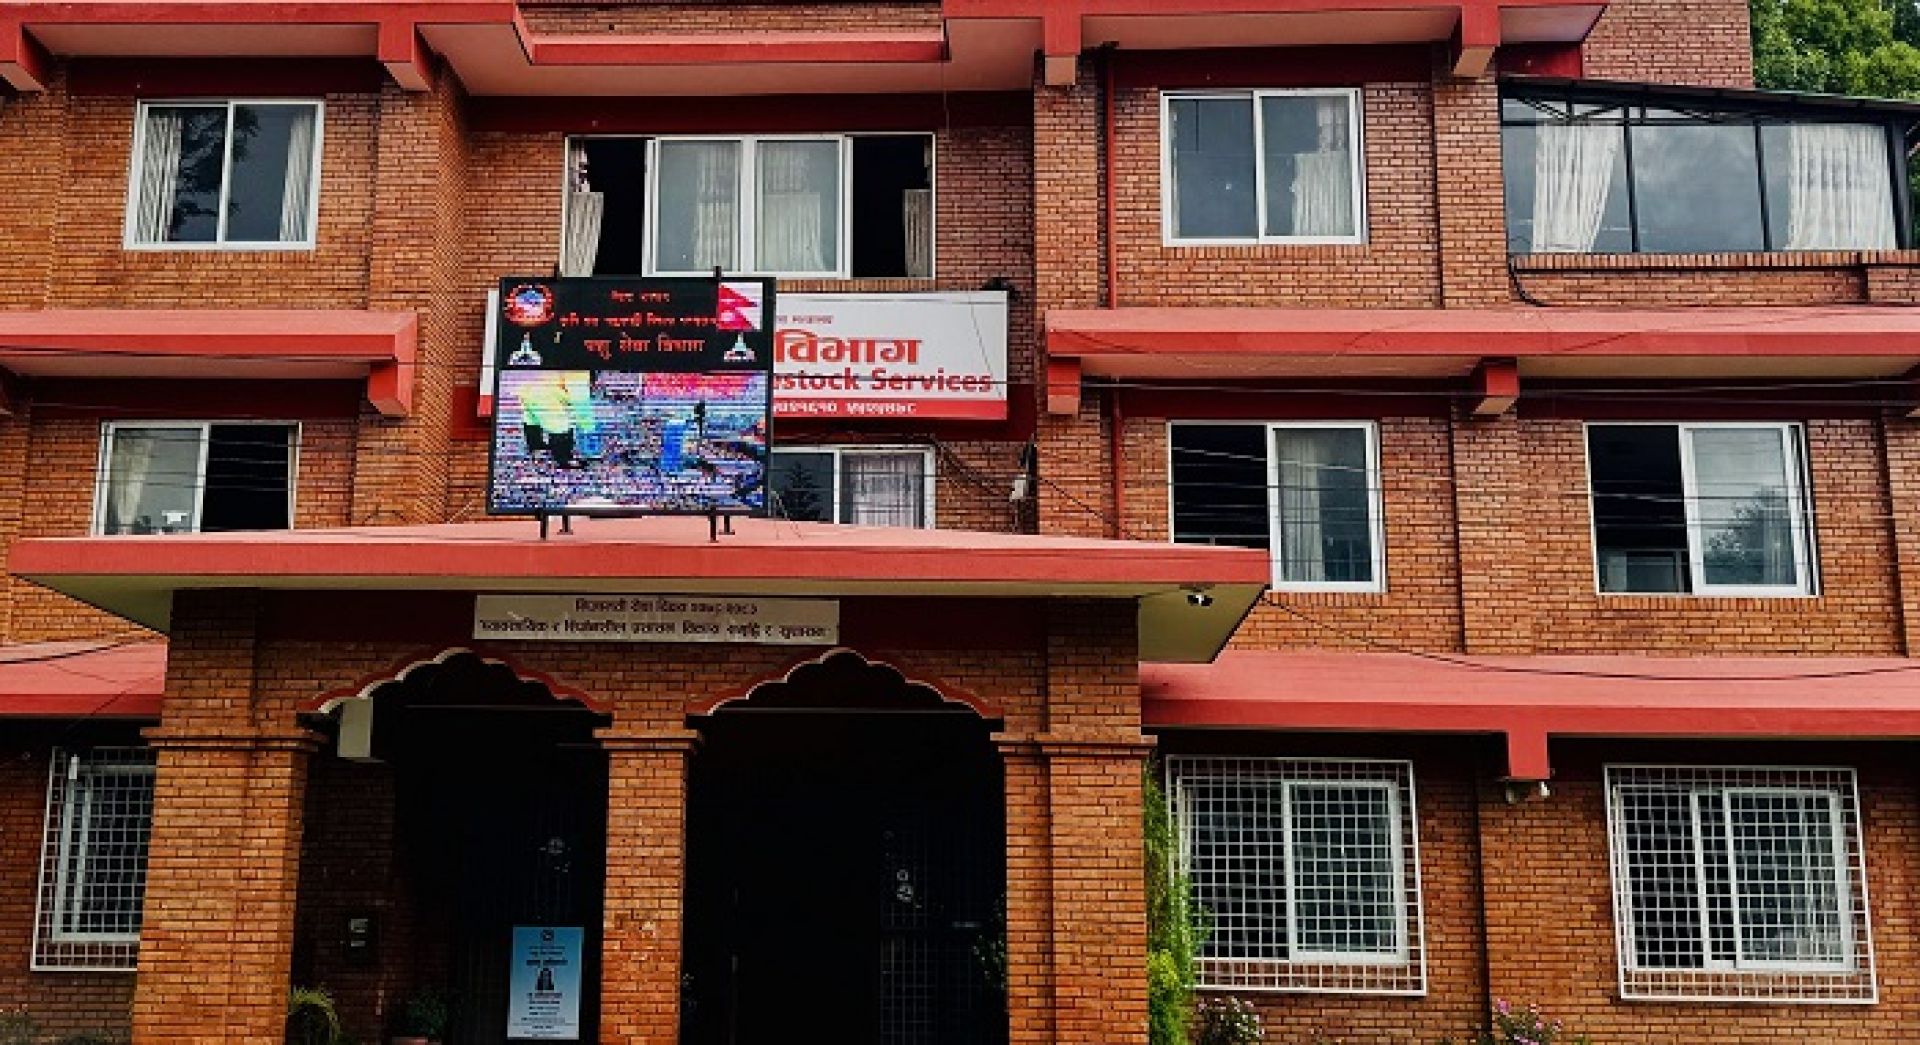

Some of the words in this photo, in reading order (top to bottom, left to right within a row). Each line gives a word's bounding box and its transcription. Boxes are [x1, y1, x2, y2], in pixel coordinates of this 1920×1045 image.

[619, 331, 651, 352] सेवा
[775, 328, 923, 364] विभाग
[871, 367, 992, 393] Services
